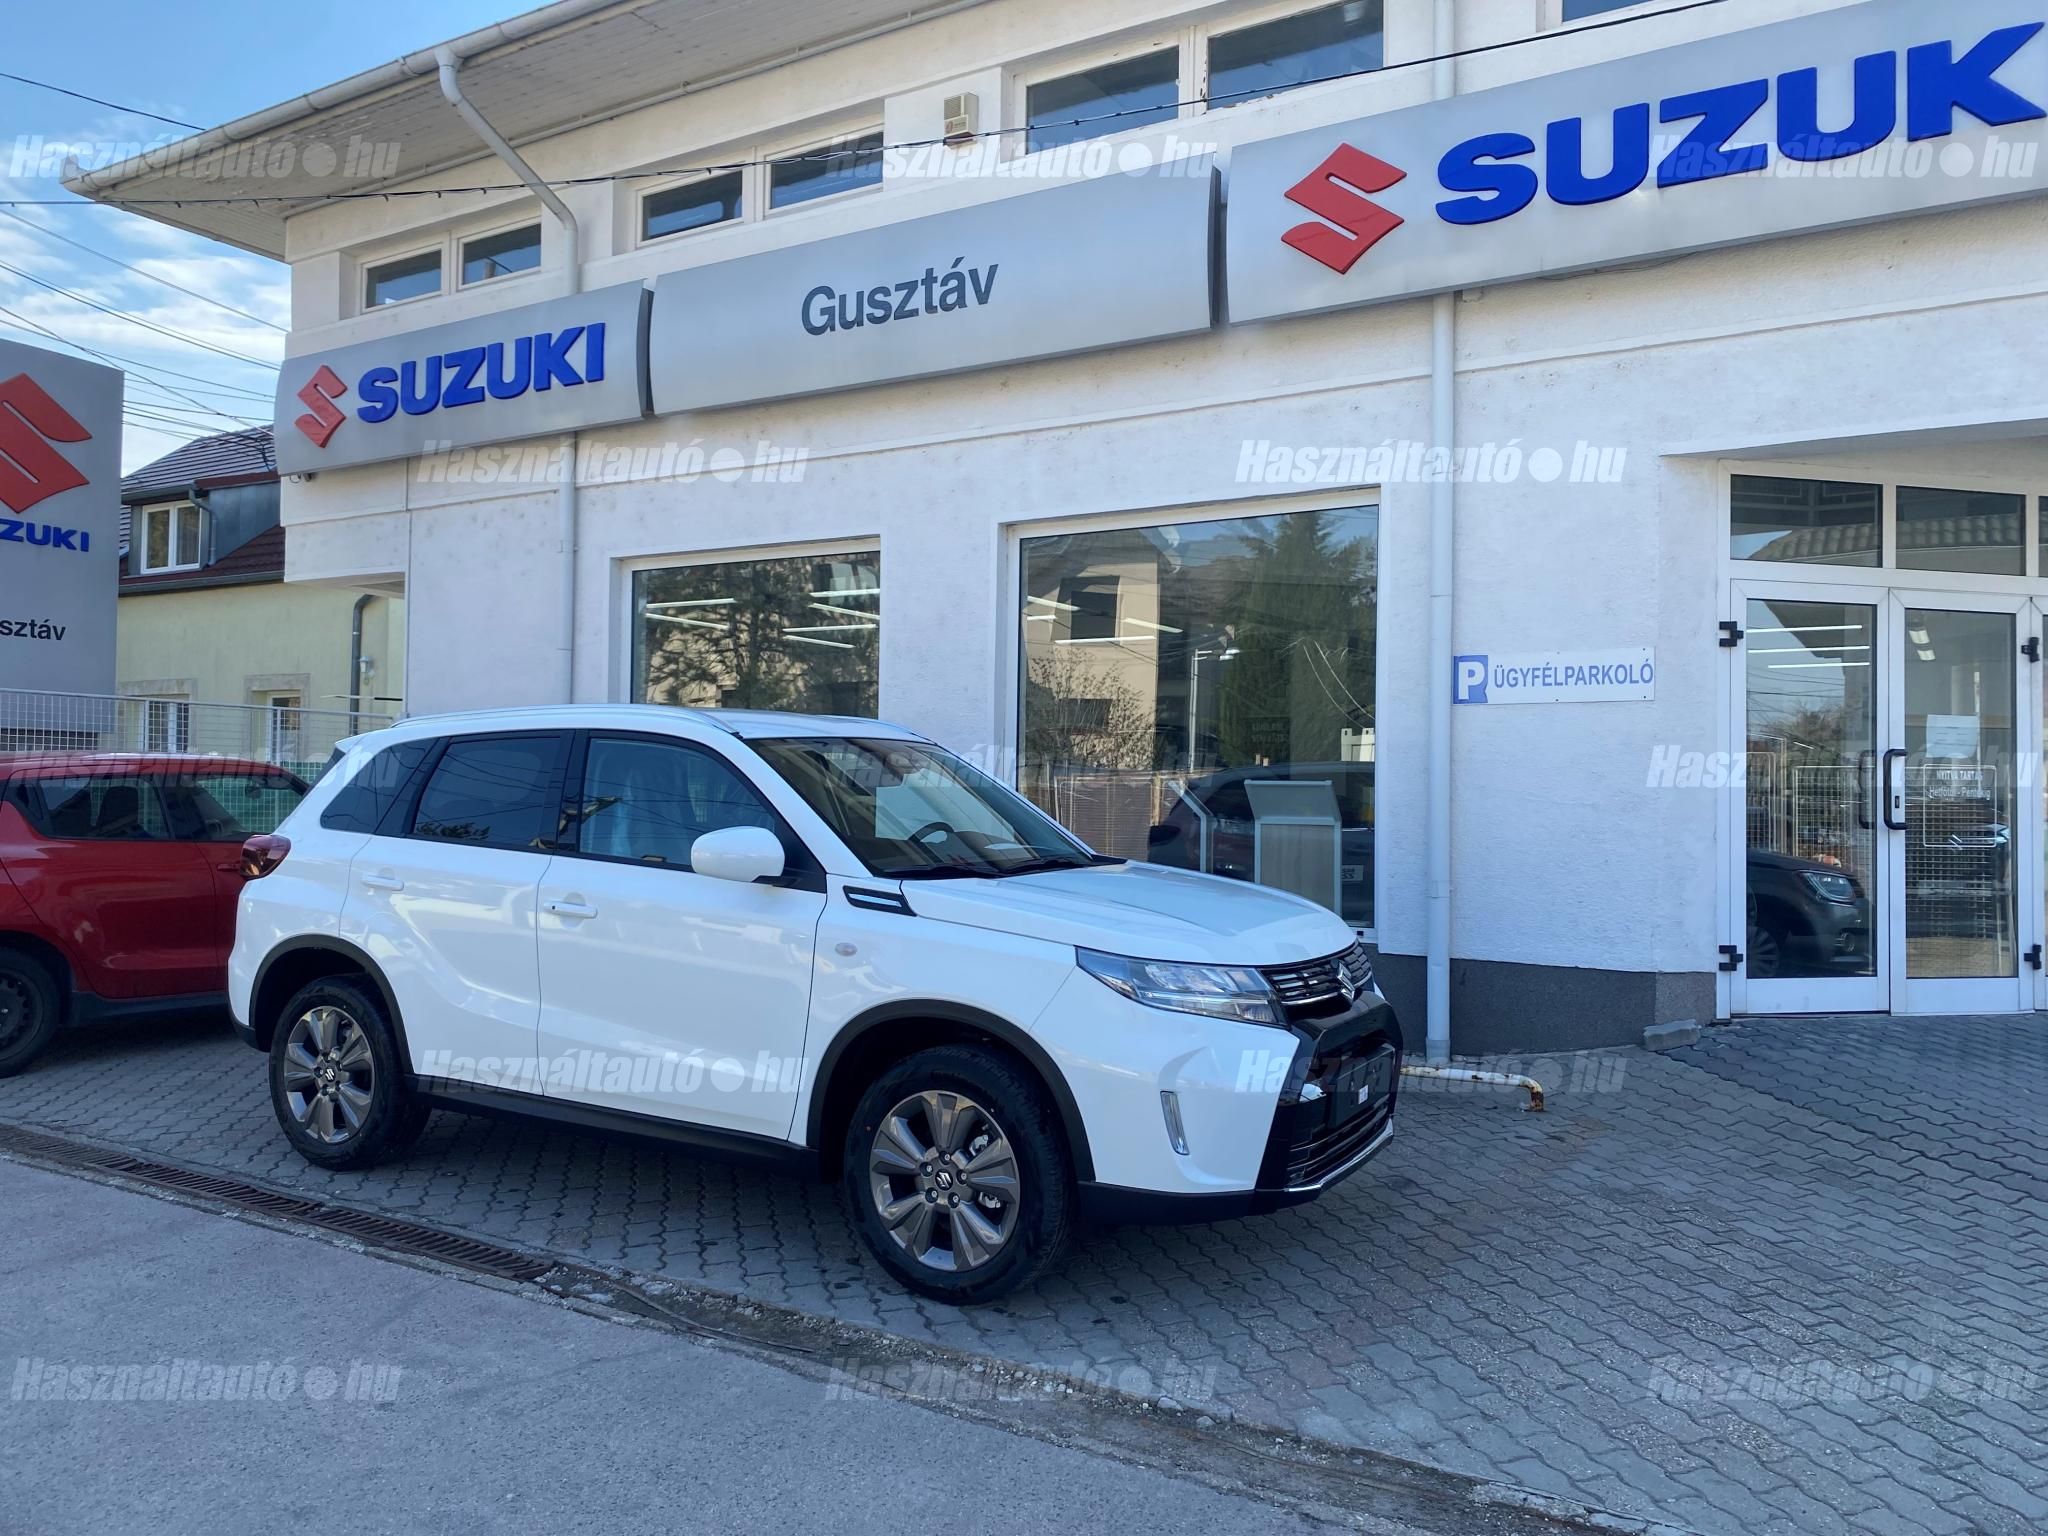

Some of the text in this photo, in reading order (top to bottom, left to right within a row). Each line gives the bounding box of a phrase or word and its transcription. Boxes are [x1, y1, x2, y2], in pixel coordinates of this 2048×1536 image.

[801, 256, 999, 335] Gusztáv
[357, 323, 606, 423] SUZUKI
[0, 518, 90, 552] ZUKI
[0, 619, 66, 641] sztáv
[1494, 659, 1654, 689] ÜGYFÉLPARKOLÓ
